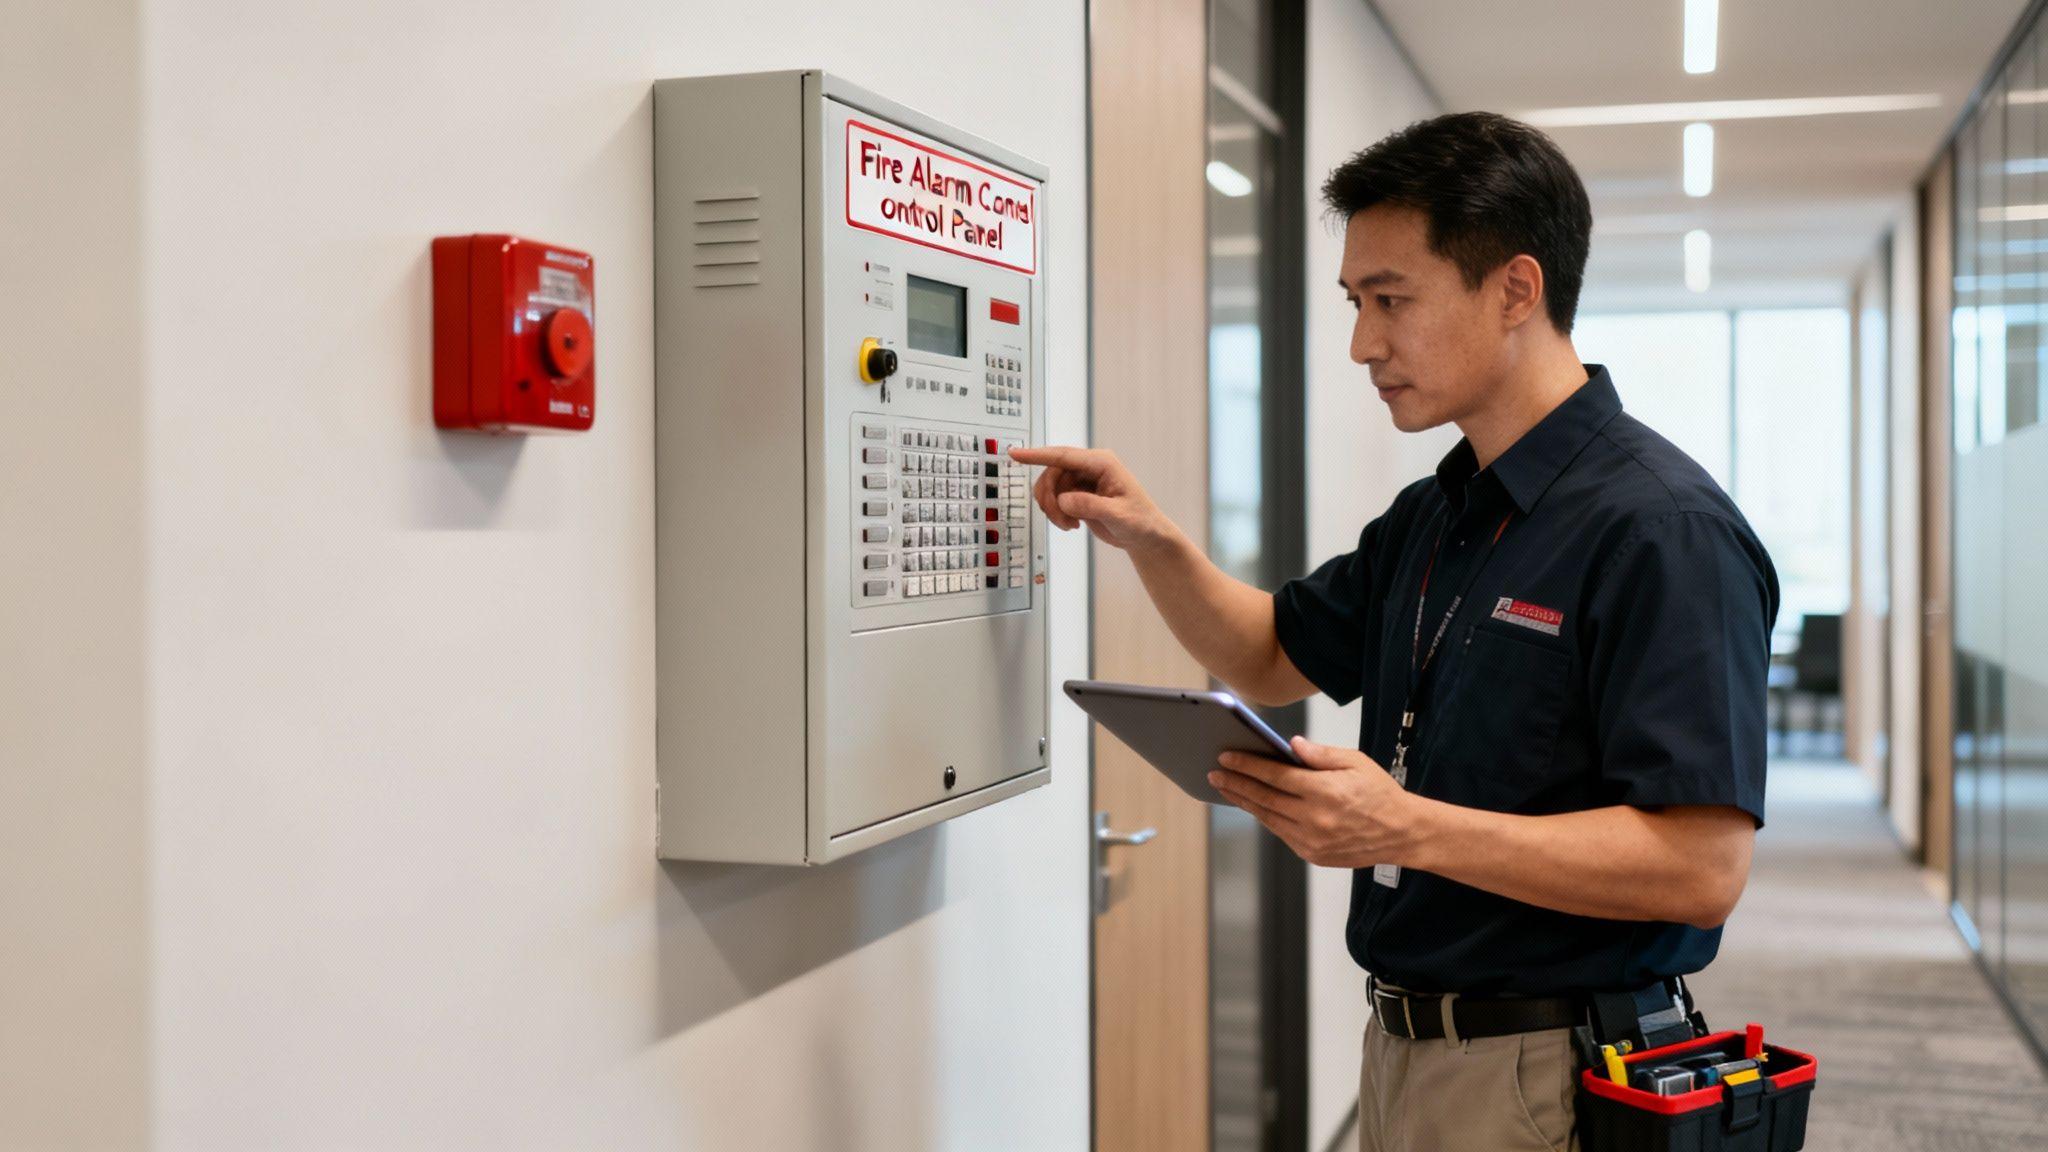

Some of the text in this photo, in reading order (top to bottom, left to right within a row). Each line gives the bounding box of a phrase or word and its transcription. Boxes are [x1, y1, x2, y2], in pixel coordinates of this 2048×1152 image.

[860, 140, 903, 184] Fire
[909, 156, 973, 206] Alarm
[952, 208, 1003, 251] Panel
